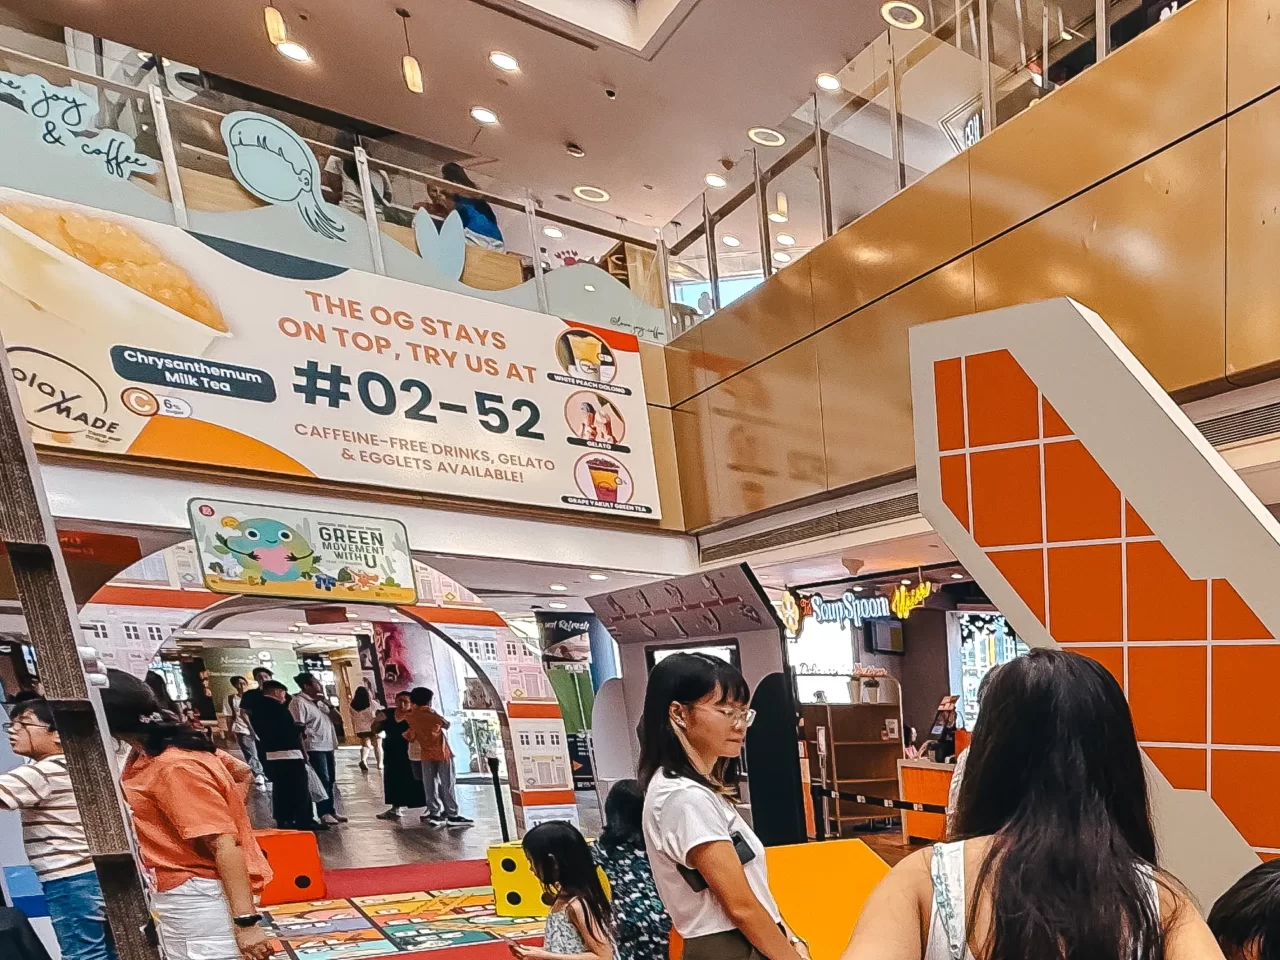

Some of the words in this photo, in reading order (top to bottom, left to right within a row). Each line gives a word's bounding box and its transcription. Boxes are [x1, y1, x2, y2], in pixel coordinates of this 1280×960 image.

[42, 120, 66, 147] &
[81, 138, 147, 178] coffee
[304, 289, 364, 321] THE
[369, 305, 415, 331] OG
[420, 316, 507, 350] STAYS
[123, 349, 263, 384] Chrysanthemum
[278, 316, 327, 344] ON
[332, 326, 401, 361] TOP,
[405, 341, 458, 369] TRY
[465, 353, 500, 377] US
[506, 362, 537, 384] AT
[164, 370, 200, 388] Milk
[201, 376, 231, 393] Tea
[49, 401, 120, 434] MADE
[292, 359, 546, 441] #02-52
[294, 423, 427, 454] CAFFEINE-FREE
[431, 442, 495, 465] DRINKS,
[497, 453, 555, 471] GELATO
[341, 447, 355, 461] &
[359, 450, 433, 471] EGGLETS
[437, 463, 524, 483] AVAILABLE!
[319, 527, 384, 546] GREEN
[322, 542, 385, 555] MOVEMENT
[334, 551, 363, 561] WITH
[364, 554, 377, 568] U
